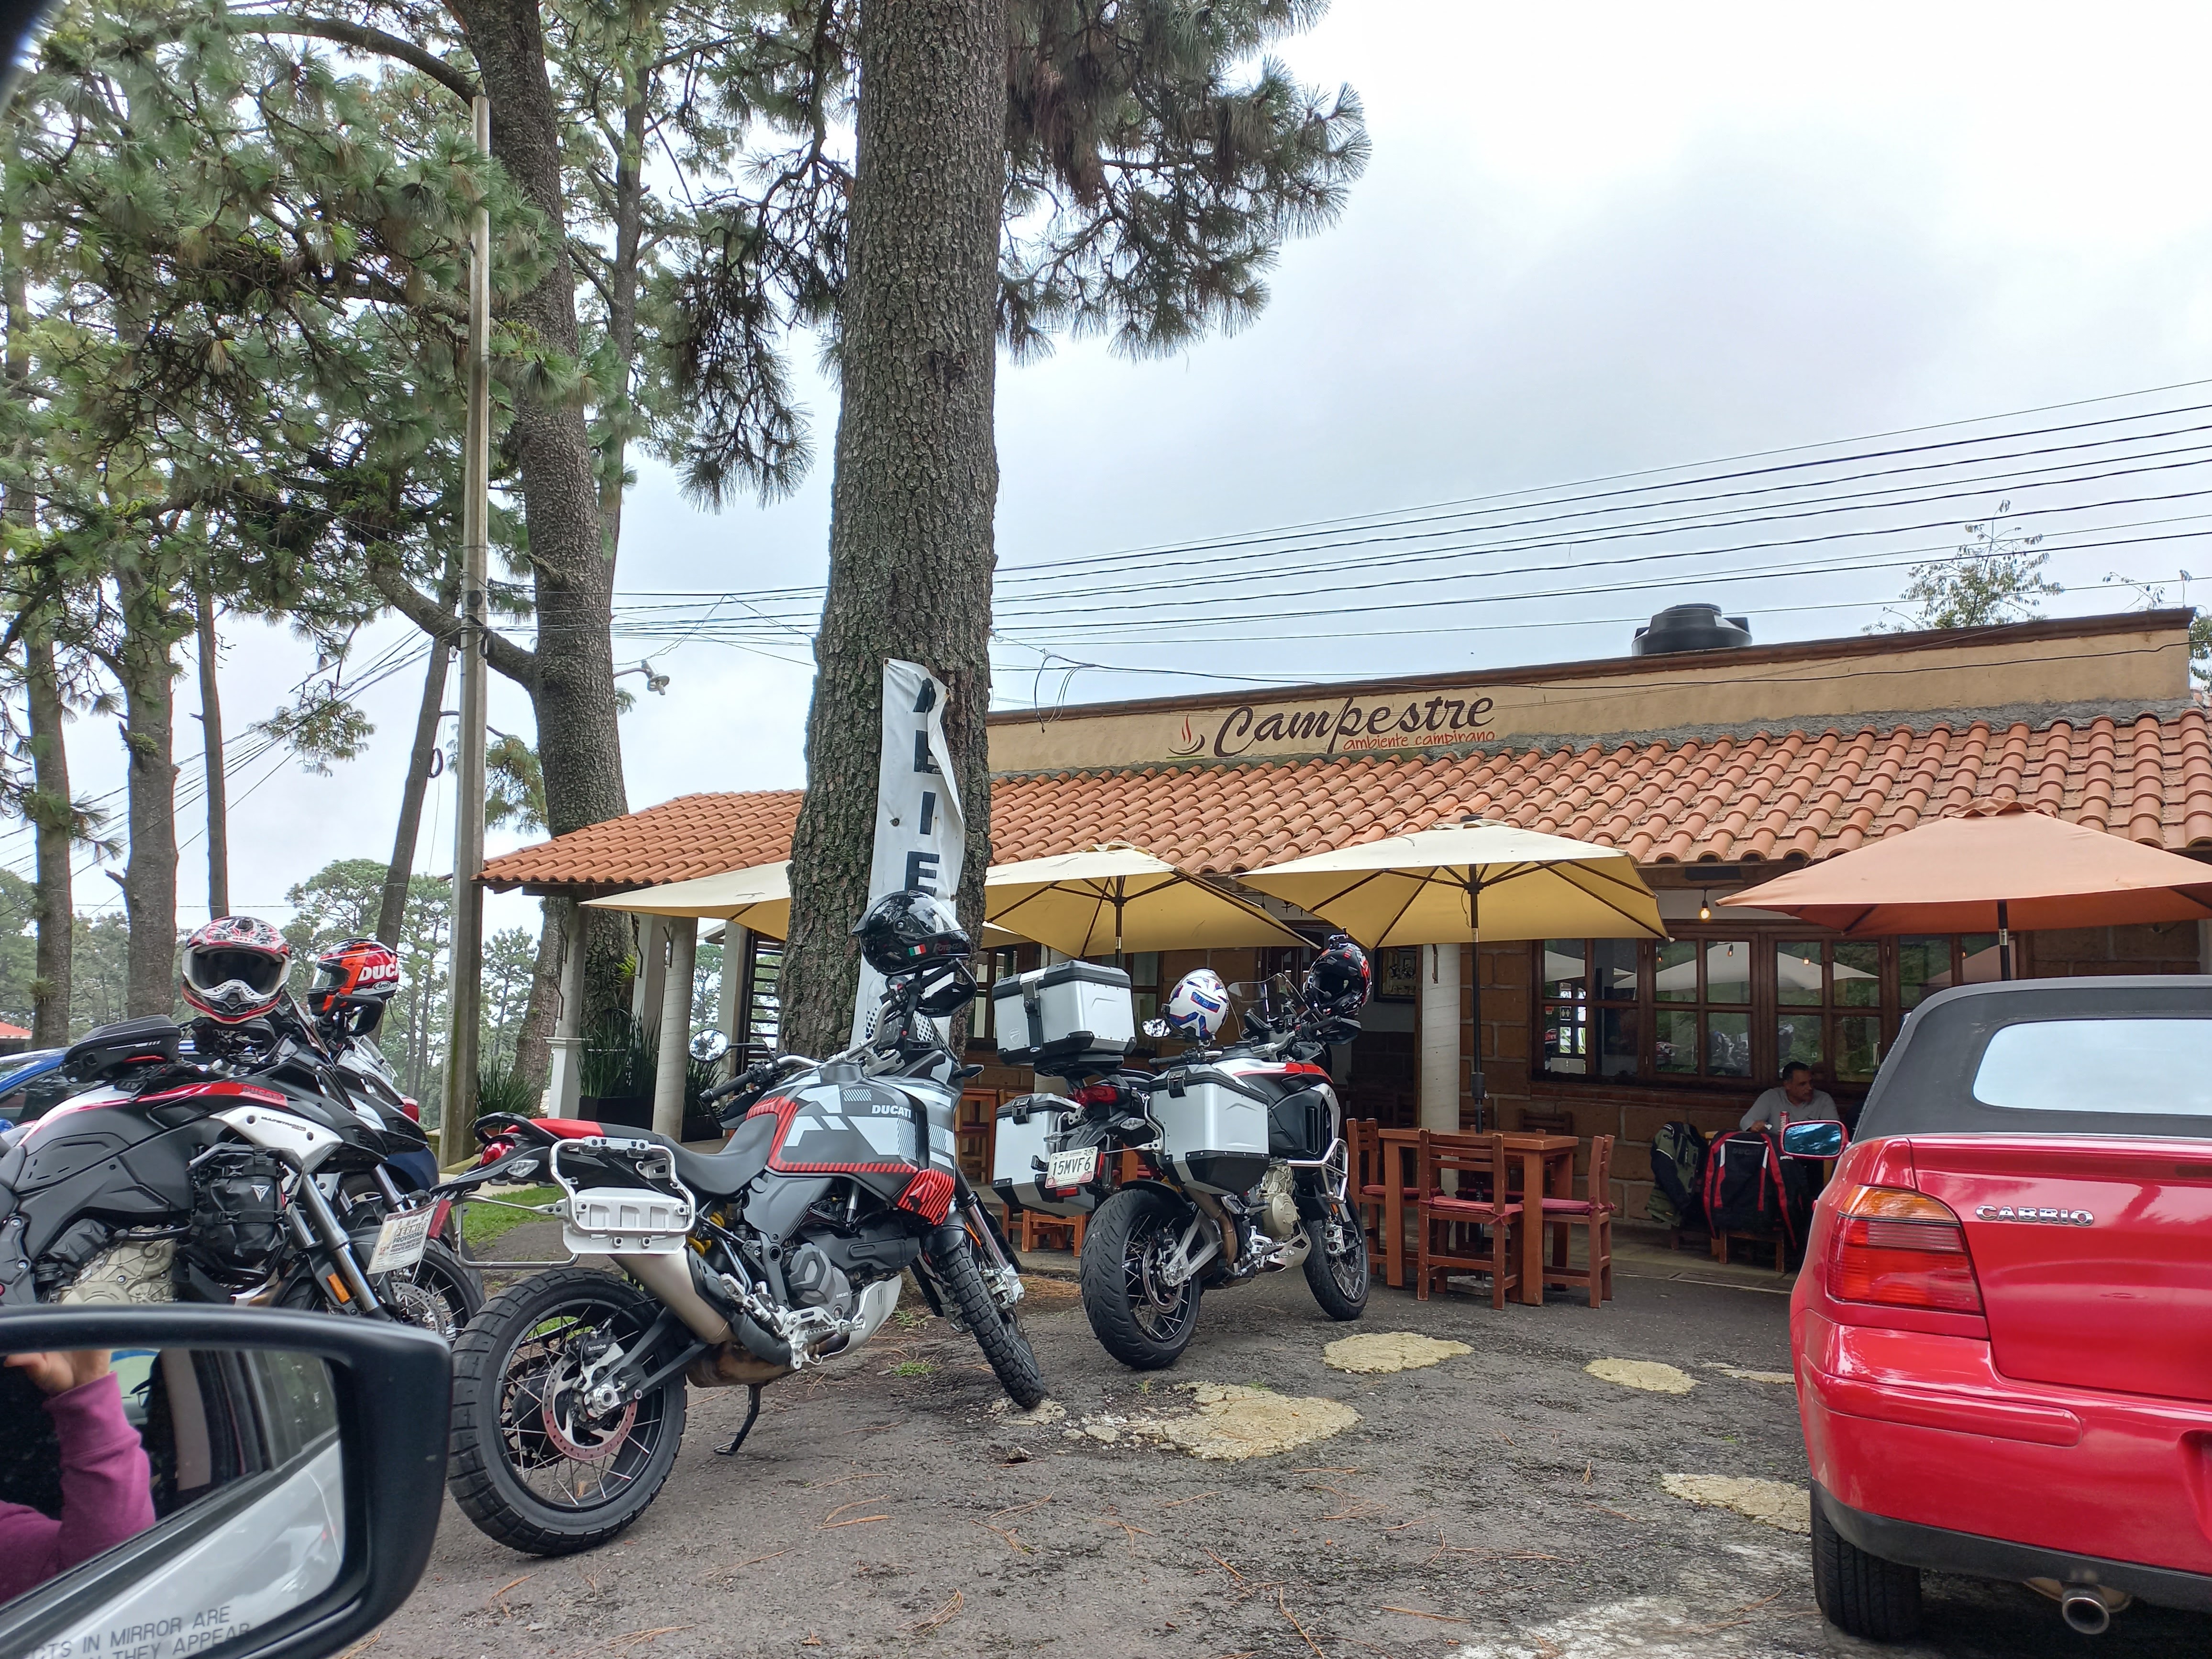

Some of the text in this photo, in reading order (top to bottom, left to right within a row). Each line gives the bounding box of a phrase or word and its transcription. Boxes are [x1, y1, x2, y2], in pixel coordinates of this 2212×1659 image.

[1214, 697, 1495, 757] Campestre
[1343, 730, 1495, 751] ambiente campirano
[242, 1085, 281, 1100] DUCATI
[872, 1105, 911, 1118] DUCATI
[1053, 1156, 1091, 1176] 15MVF6
[1975, 1205, 2094, 1226] CABRIO
[395, 1220, 428, 1237] PERMISO
[83, 1634, 100, 1653] IN
[110, 1617, 182, 1648] MIRROR
[192, 1606, 230, 1629] ARE
